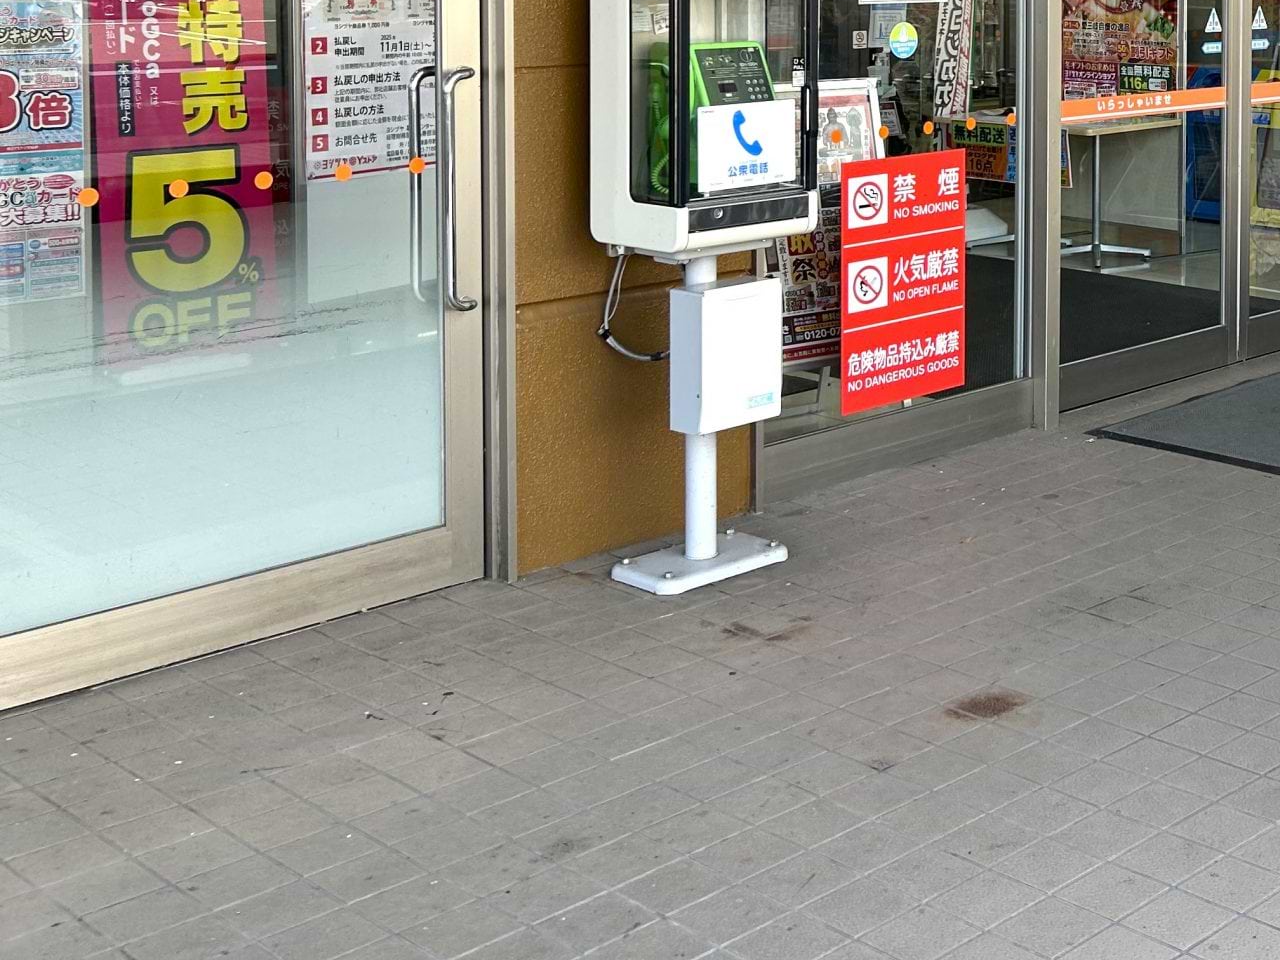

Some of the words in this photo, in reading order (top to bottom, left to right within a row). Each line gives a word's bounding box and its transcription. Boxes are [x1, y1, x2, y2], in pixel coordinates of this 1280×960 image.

[315, 41, 324, 53] 2
[315, 79, 323, 89] 3
[334, 72, 401, 86] 払戻しの申出方法
[117, 63, 131, 133] 本体価格より
[1097, 94, 1173, 111] いらっしゃいませ
[315, 111, 323, 123] 4
[335, 104, 384, 118] 払戻しの方法
[316, 137, 324, 149] 5
[728, 162, 769, 178] 公衆電話
[893, 166, 960, 203] 禁煙
[893, 207, 910, 219] NO
[912, 200, 959, 217] SMOKING
[893, 246, 959, 287] 火気厳禁
[893, 291, 905, 302] NO
[907, 286, 931, 299] OPEN
[931, 279, 959, 294] FLAME
[133, 292, 252, 347] OFF
[847, 329, 960, 377] 危険物品持込み厳禁
[847, 380, 863, 392] NO
[865, 365, 925, 388] DANGEROUS
[927, 356, 959, 373] GOODS
